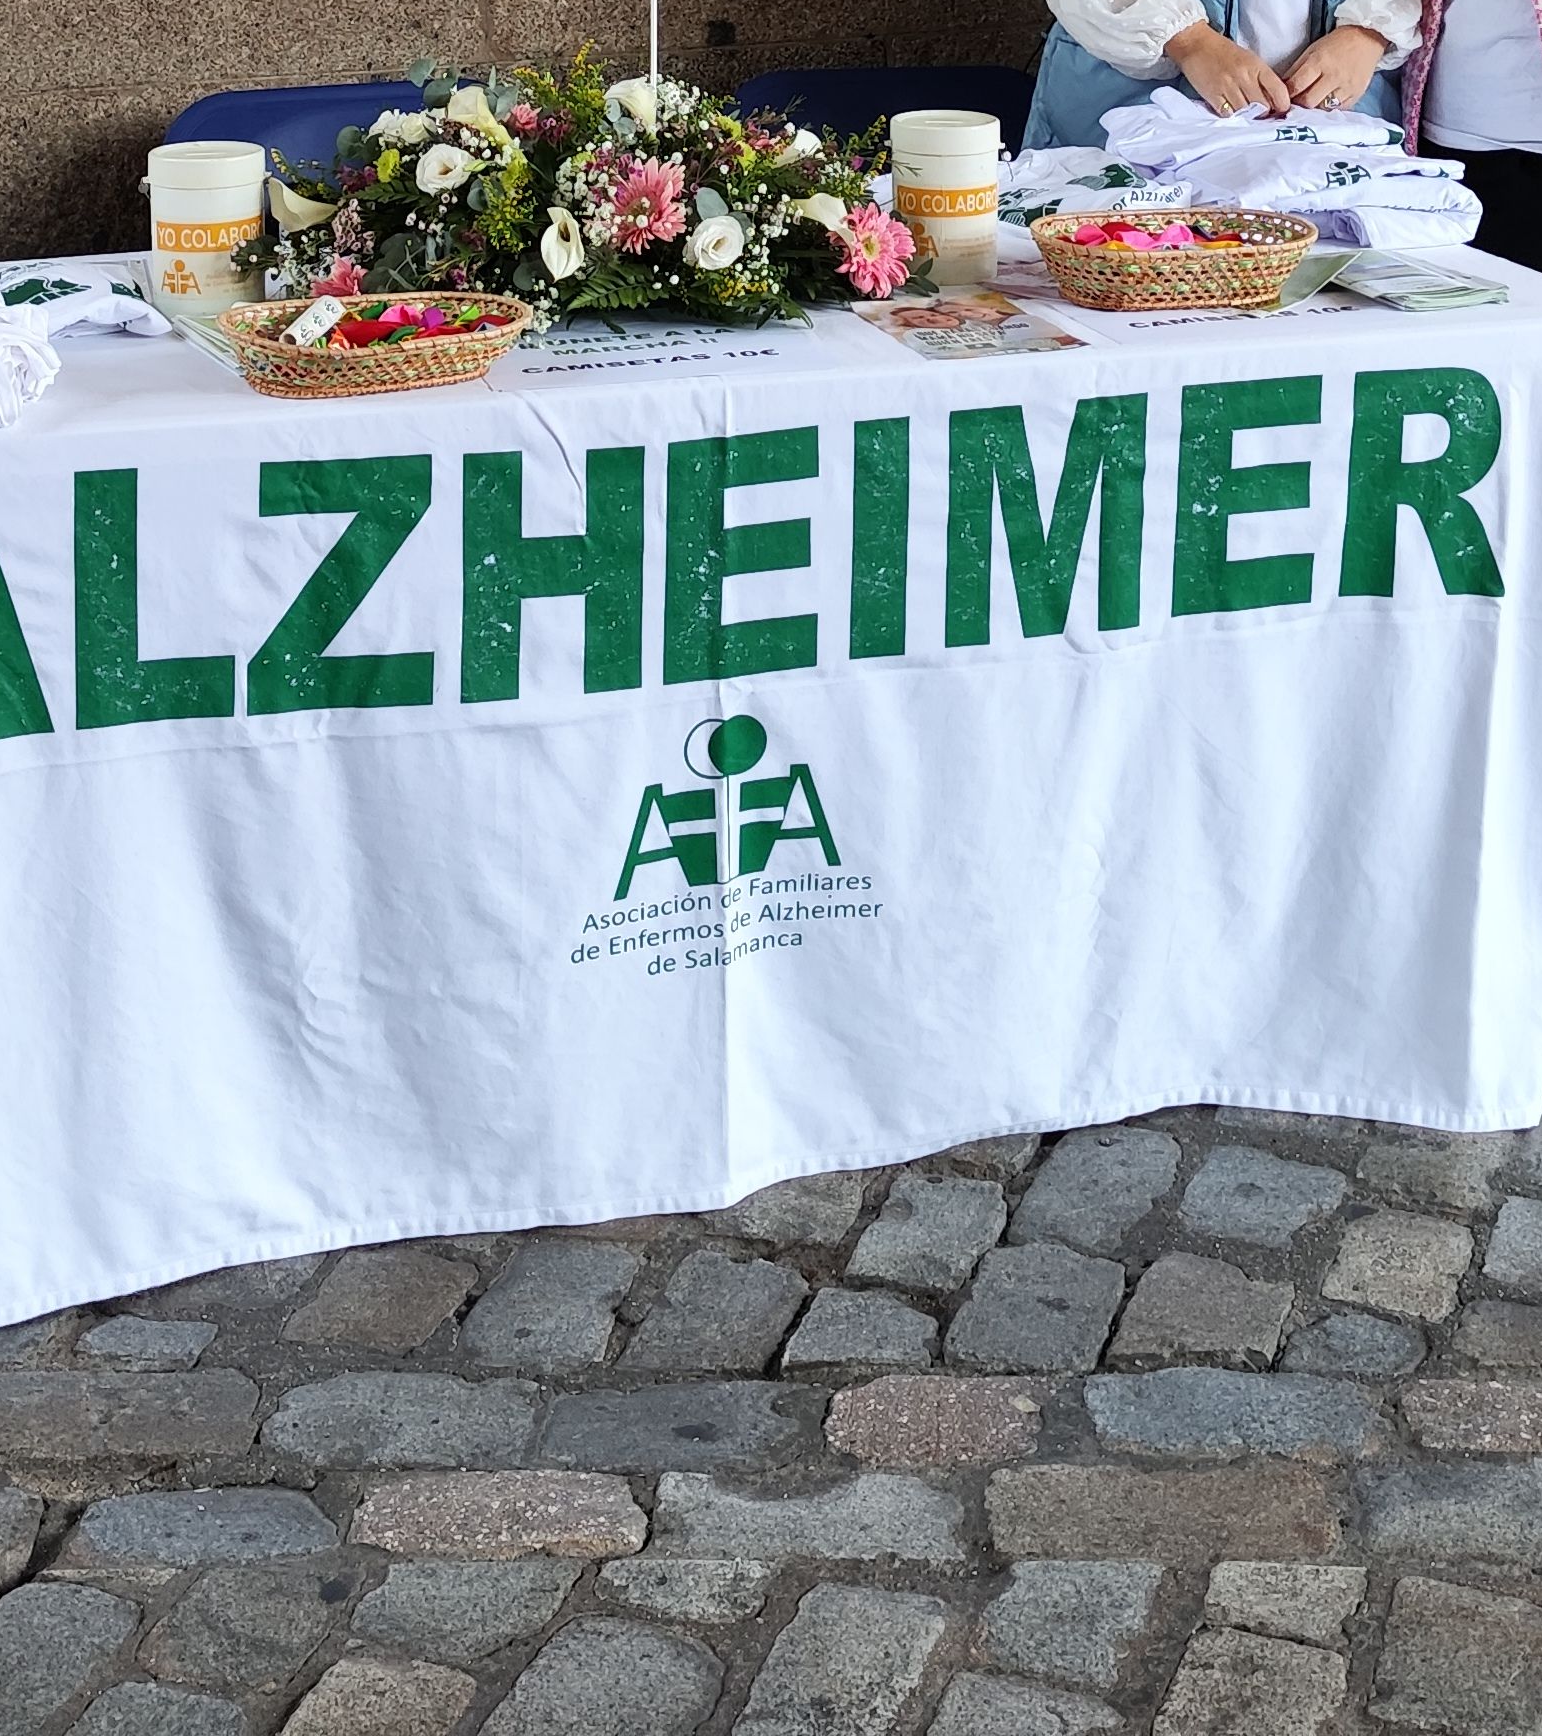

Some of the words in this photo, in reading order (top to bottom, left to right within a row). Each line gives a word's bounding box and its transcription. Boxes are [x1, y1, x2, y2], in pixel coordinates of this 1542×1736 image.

[900, 191, 917, 211] YO
[157, 226, 177, 248] YO
[664, 330, 685, 338] A
[693, 327, 735, 336] LA
[552, 339, 692, 356] MARCHA
[521, 352, 711, 375] CAMISETAS
[722, 348, 781, 359] 10€
[582, 891, 712, 935] Asociación
[720, 886, 742, 909] de
[749, 872, 872, 897] Familiares
[569, 942, 601, 965] de
[608, 922, 725, 957] Enfermos
[729, 912, 751, 934] de
[758, 898, 884, 924] Alzheimer
[646, 954, 677, 976] de
[684, 931, 804, 970] Salamanca
